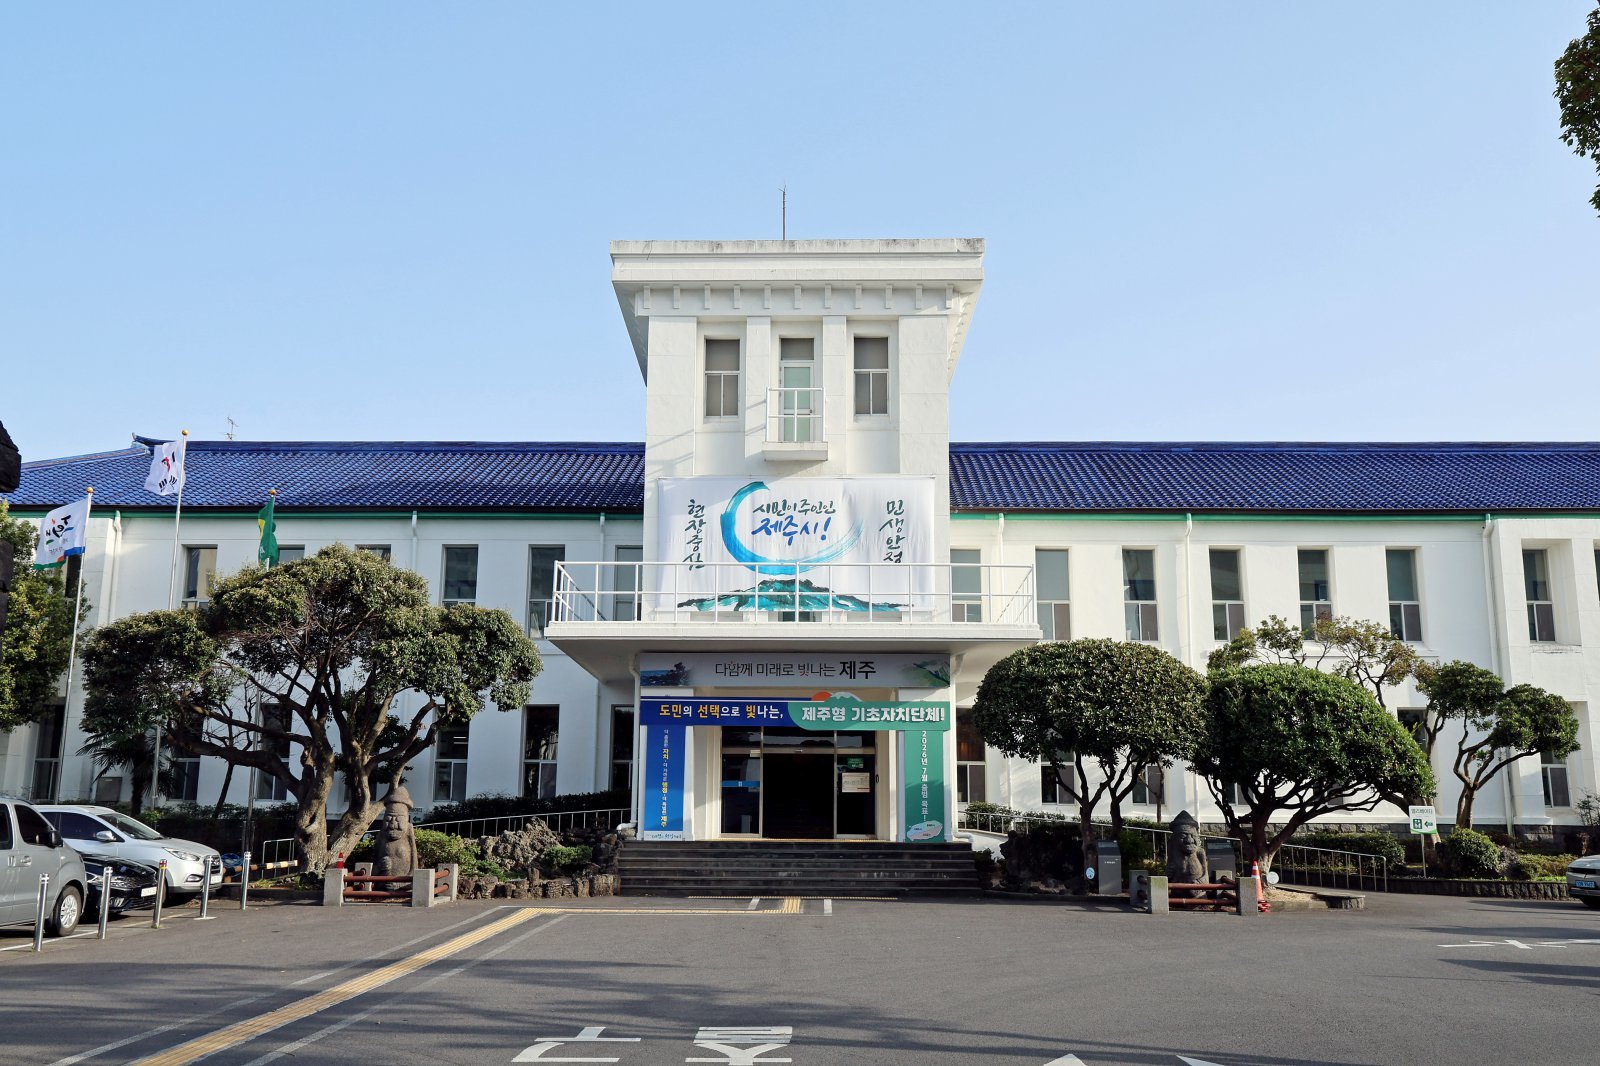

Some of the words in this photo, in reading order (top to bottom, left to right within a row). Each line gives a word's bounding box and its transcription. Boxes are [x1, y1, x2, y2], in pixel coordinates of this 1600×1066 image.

[751, 515, 831, 546] 제주시!
[715, 661, 752, 677] 다함께
[757, 663, 795, 677] 미래로
[839, 661, 876, 680] 제주
[659, 704, 693, 718] 도민의
[698, 704, 740, 719] 선택으로
[746, 705, 784, 719] 빛나는,
[802, 707, 846, 722] 제주형
[851, 707, 945, 722] 기초자치단체!
[921, 768, 928, 782] 7월
